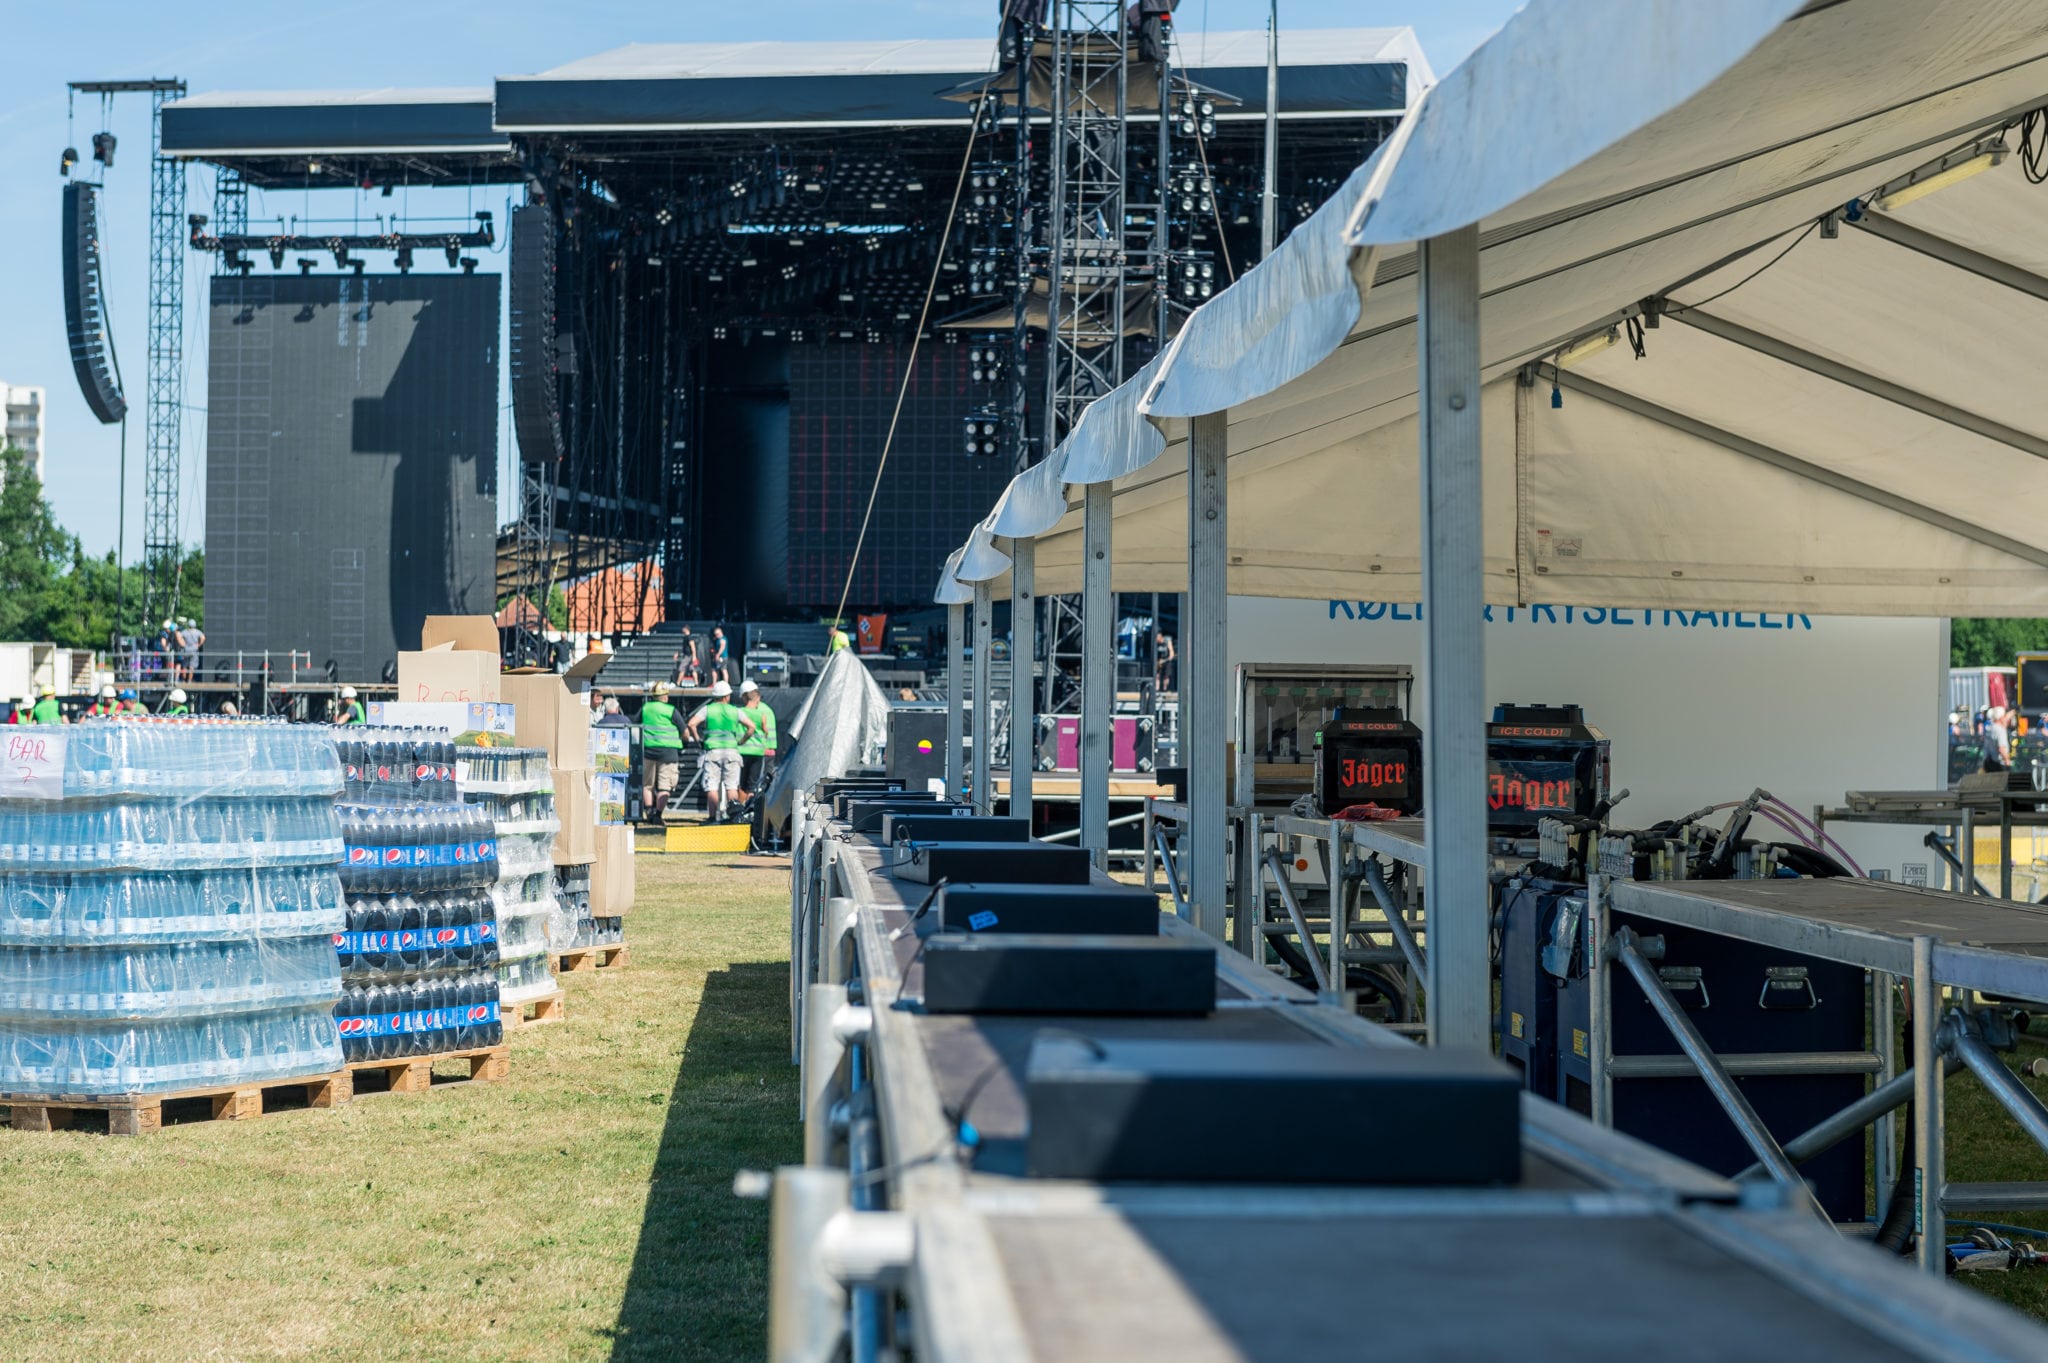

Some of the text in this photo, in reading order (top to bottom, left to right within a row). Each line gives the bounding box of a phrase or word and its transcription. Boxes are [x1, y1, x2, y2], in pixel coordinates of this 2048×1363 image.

[1348, 723, 1398, 731] ICE COLD!
[1499, 727, 1563, 737] ICE COLD!
[9, 735, 50, 763] BAR
[1341, 758, 1405, 788] Jäger
[1488, 773, 1571, 812] Jäger
